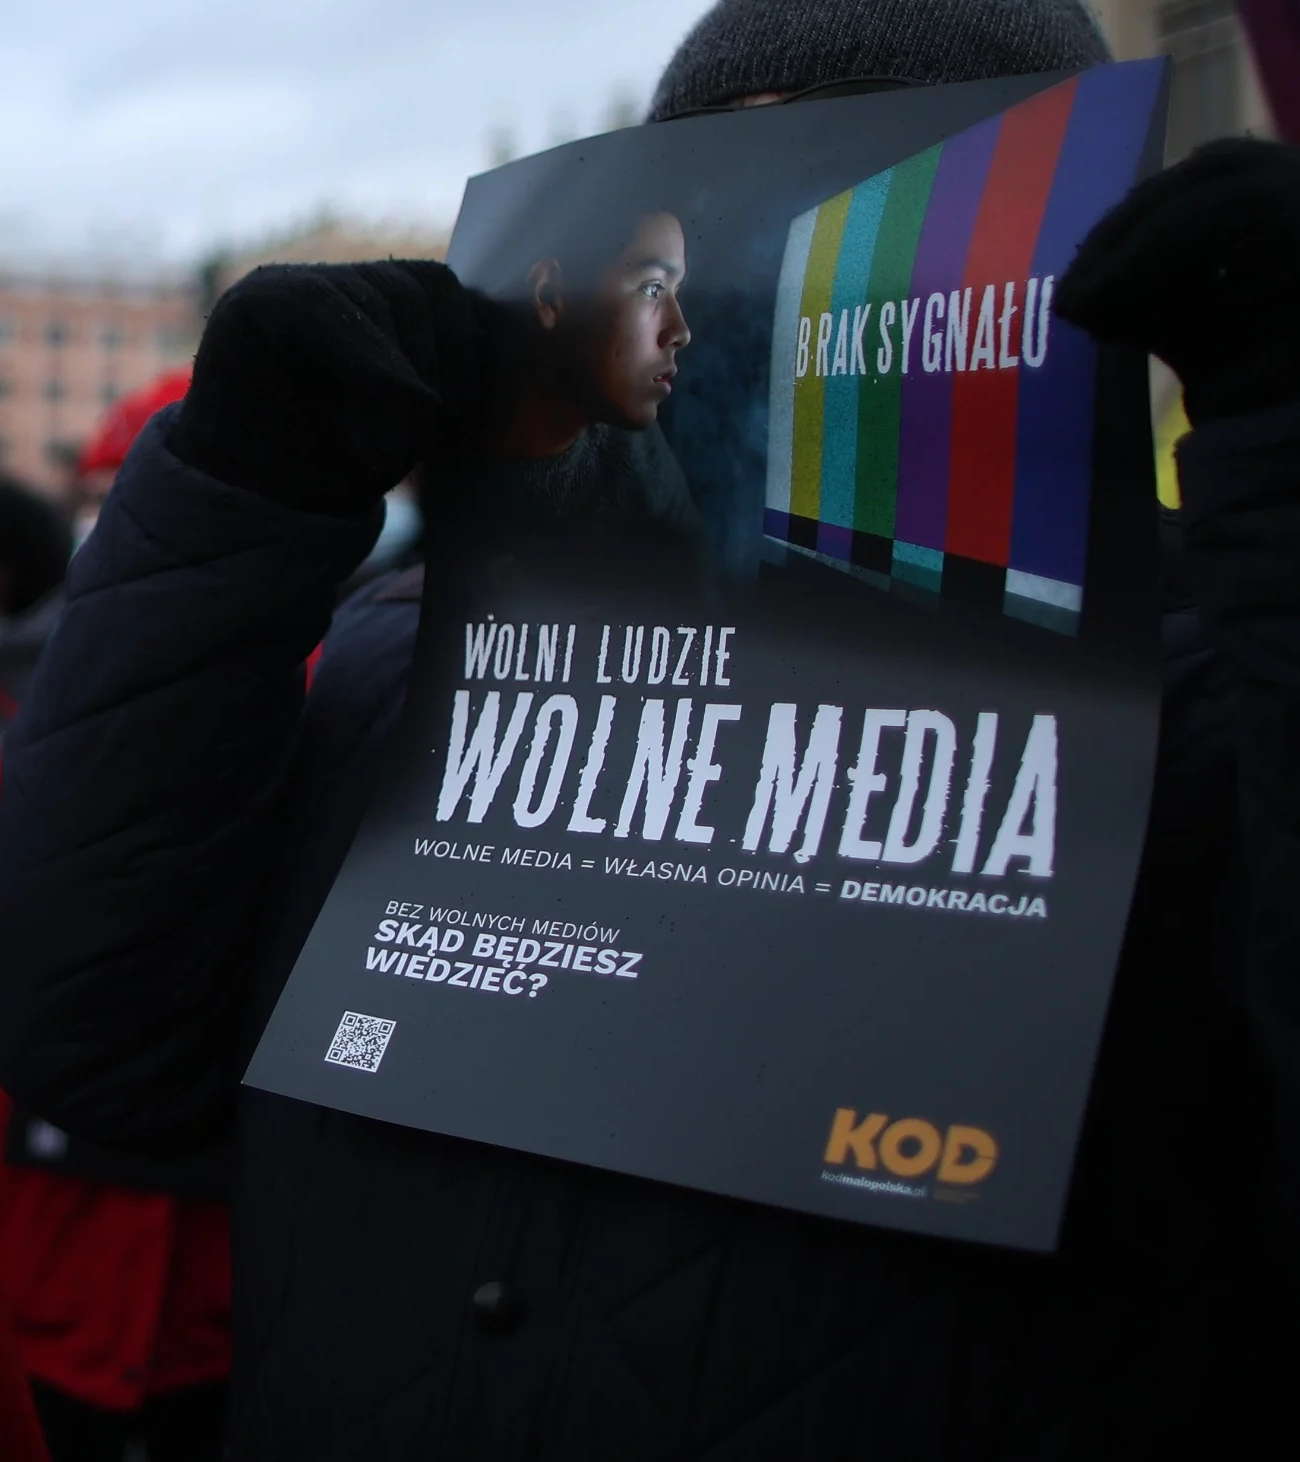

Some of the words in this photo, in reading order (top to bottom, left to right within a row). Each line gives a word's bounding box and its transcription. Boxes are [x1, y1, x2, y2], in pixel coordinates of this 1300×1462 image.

[796, 304, 871, 377] BRAK
[877, 275, 1054, 374] SYGNAŁU
[464, 620, 576, 683] WOLNI
[597, 624, 735, 686] LUDZIE
[435, 690, 742, 842] WOLNE
[742, 703, 1057, 877] MEDIA
[413, 837, 493, 864] WOLNE
[501, 846, 574, 871] MEDIA
[604, 856, 708, 884] WŁASNA
[717, 868, 805, 894] OPINIA
[839, 879, 1049, 918] DEMOKRACJA
[374, 919, 464, 957] SKĄD
[472, 933, 643, 978] BĘDZIESZ
[385, 900, 424, 919] BEZ
[429, 906, 525, 933] WOLNYCH
[531, 919, 620, 943] MEDIÓW
[365, 946, 548, 998] WIEDZIEĆ?
[824, 1107, 998, 1184] KOD
